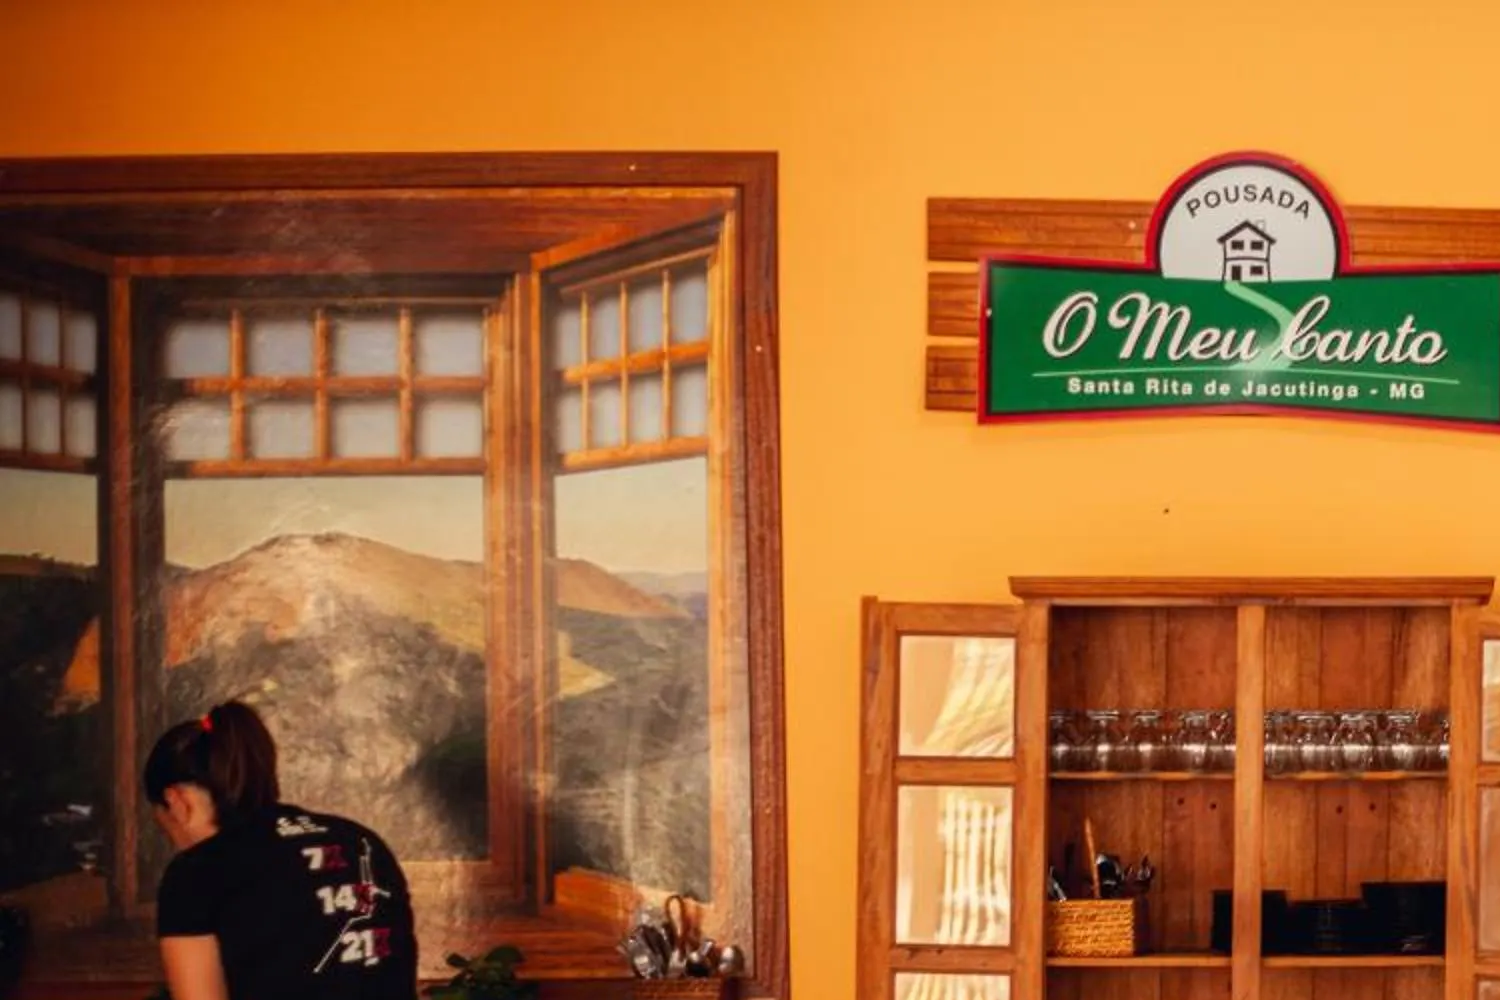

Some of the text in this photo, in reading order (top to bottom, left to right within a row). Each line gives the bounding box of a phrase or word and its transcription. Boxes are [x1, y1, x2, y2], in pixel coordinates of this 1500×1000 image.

[1185, 183, 1312, 220] POUSADA
[1042, 290, 1448, 366] O Meu Canto
[1067, 377, 1135, 395] Santa
[1145, 378, 1194, 396] Rita
[1203, 379, 1231, 397] de
[1241, 379, 1360, 401] Jacutinga
[1388, 383, 1425, 400] MG
